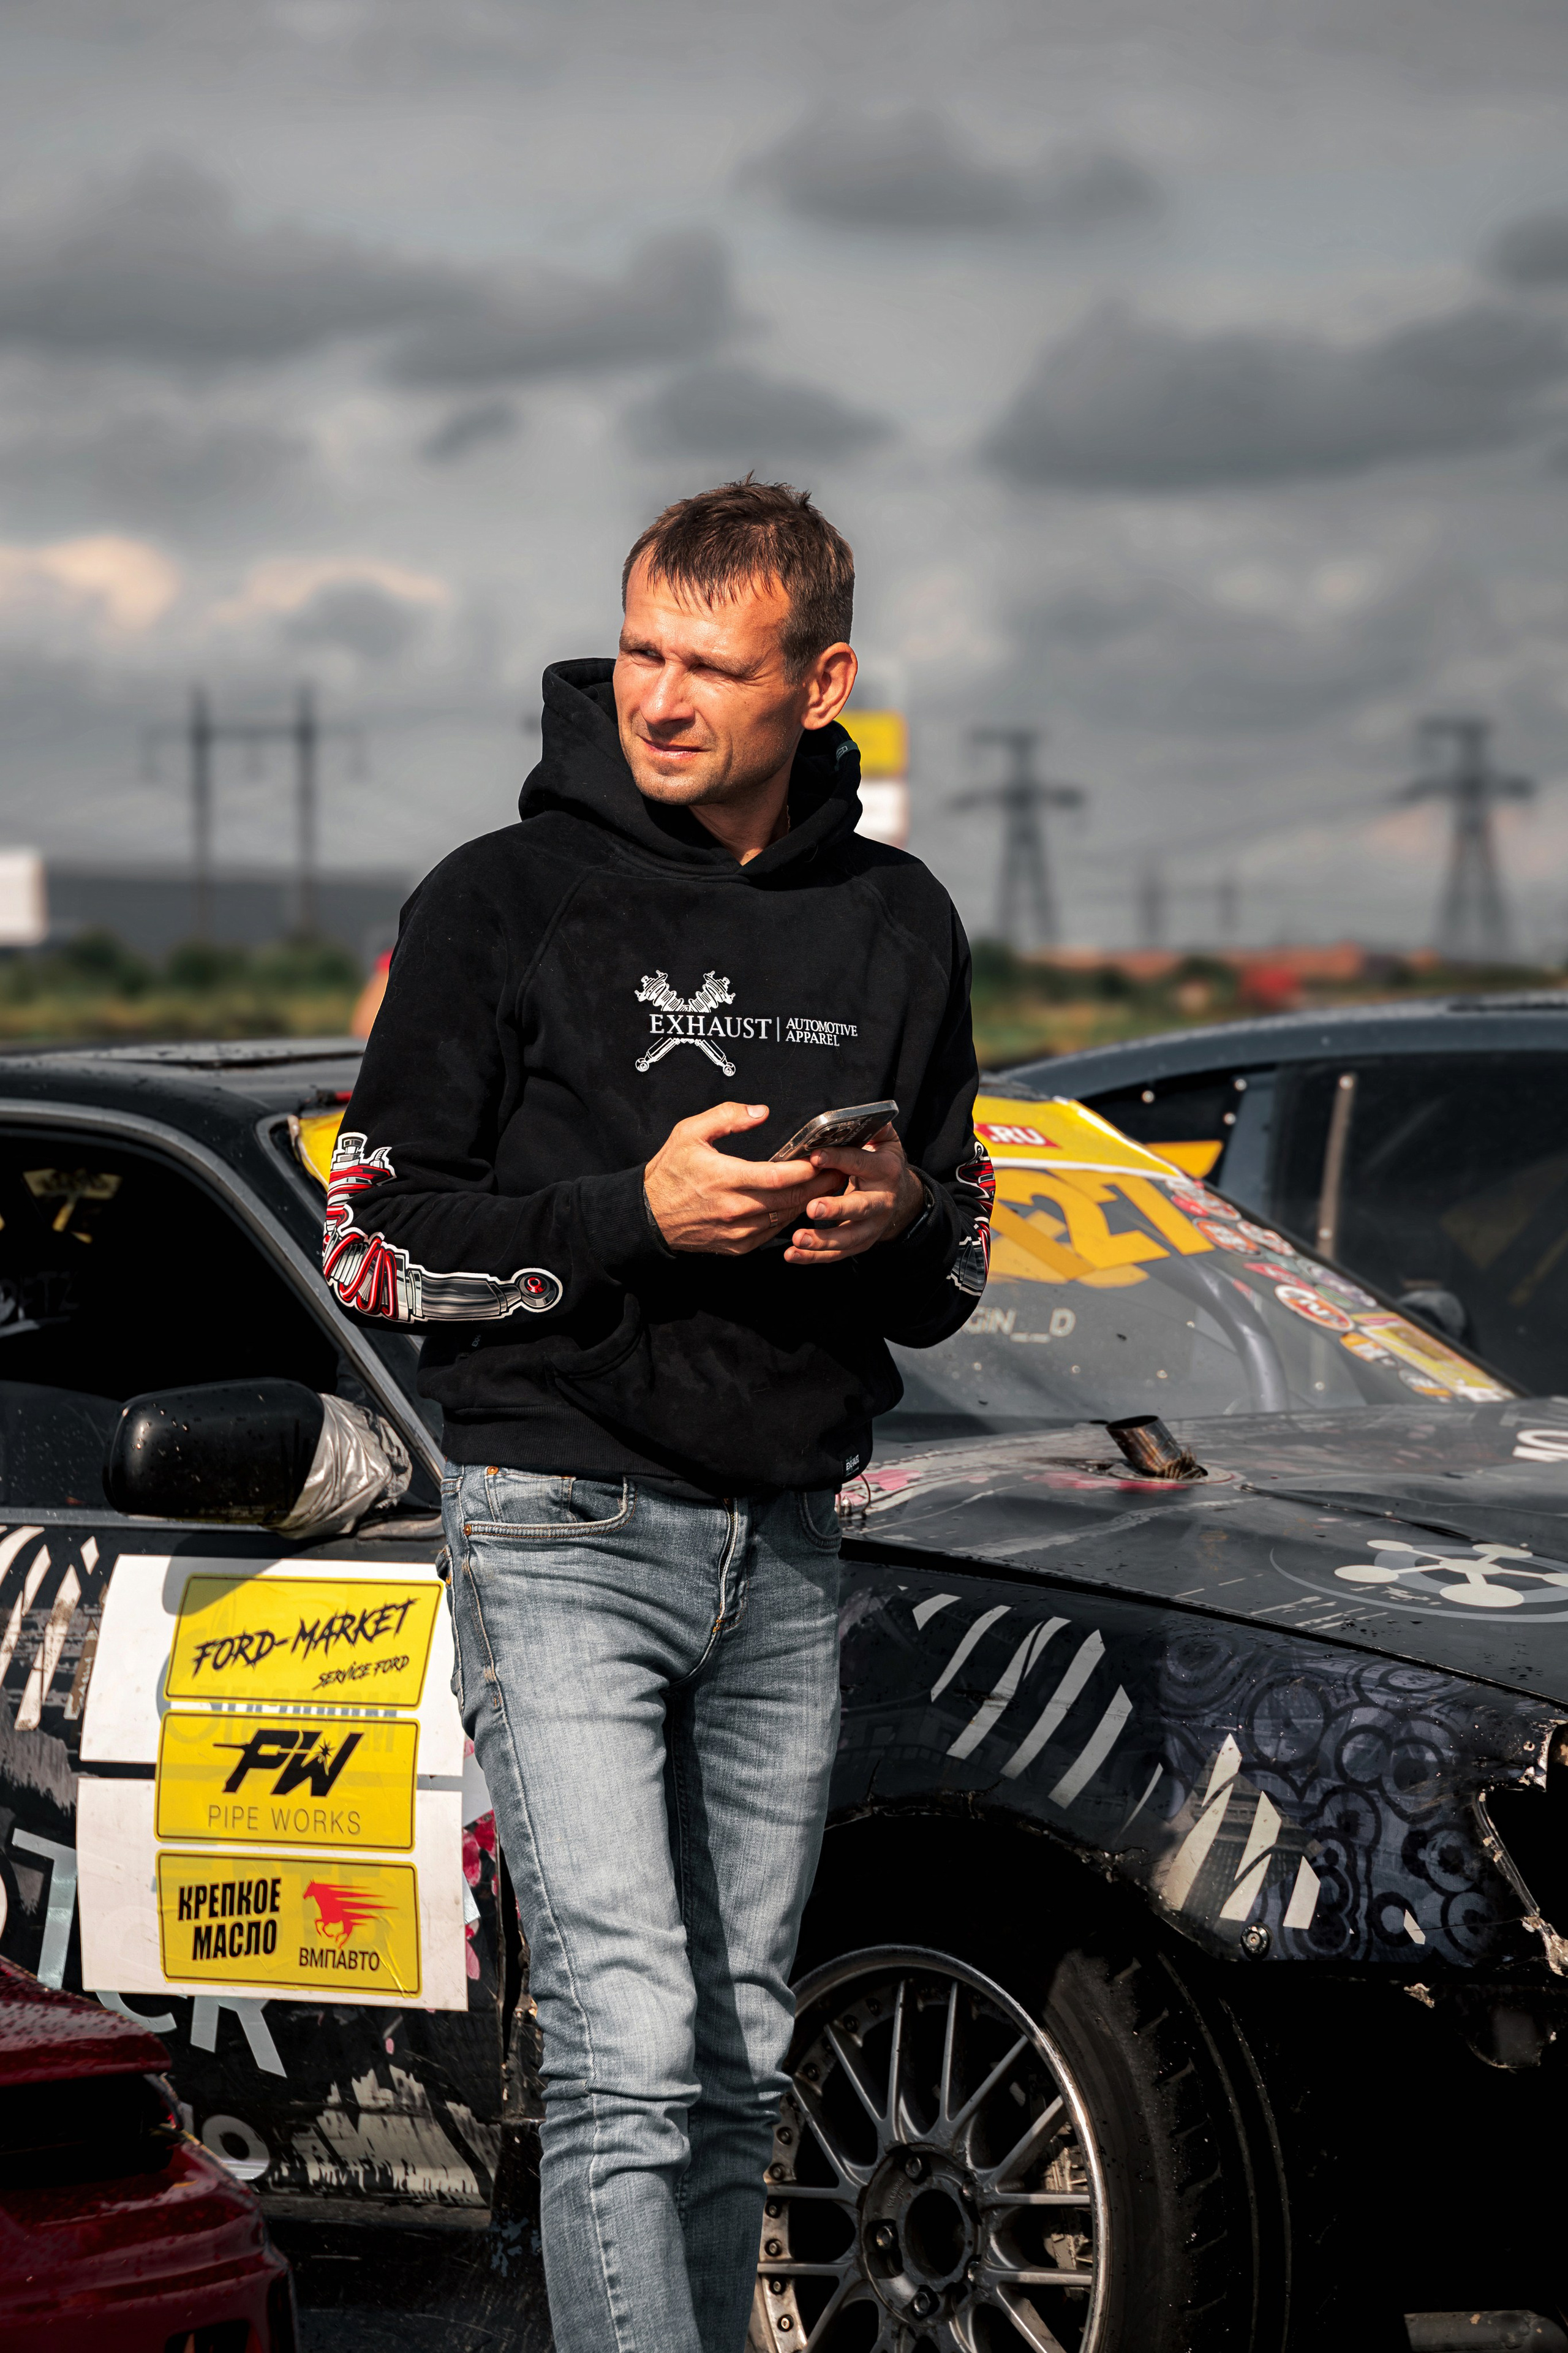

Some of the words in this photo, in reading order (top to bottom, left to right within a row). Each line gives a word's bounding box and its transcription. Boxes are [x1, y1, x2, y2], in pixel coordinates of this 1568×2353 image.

[649, 1014, 772, 1040] EXHAUST
[785, 1030, 840, 1046] APPAREL
[786, 1017, 858, 1037] AUTOMOTIVE
[192, 1597, 420, 1679] FORD-MARKET
[374, 1655, 410, 1677] FORD
[208, 1805, 259, 1830] PIPE
[271, 1807, 361, 1835] WORKS
[178, 1877, 282, 1922] КРЕПКОЕ
[192, 1919, 278, 1961] МАСЛО
[299, 1946, 380, 1971] ВМПАВТО
